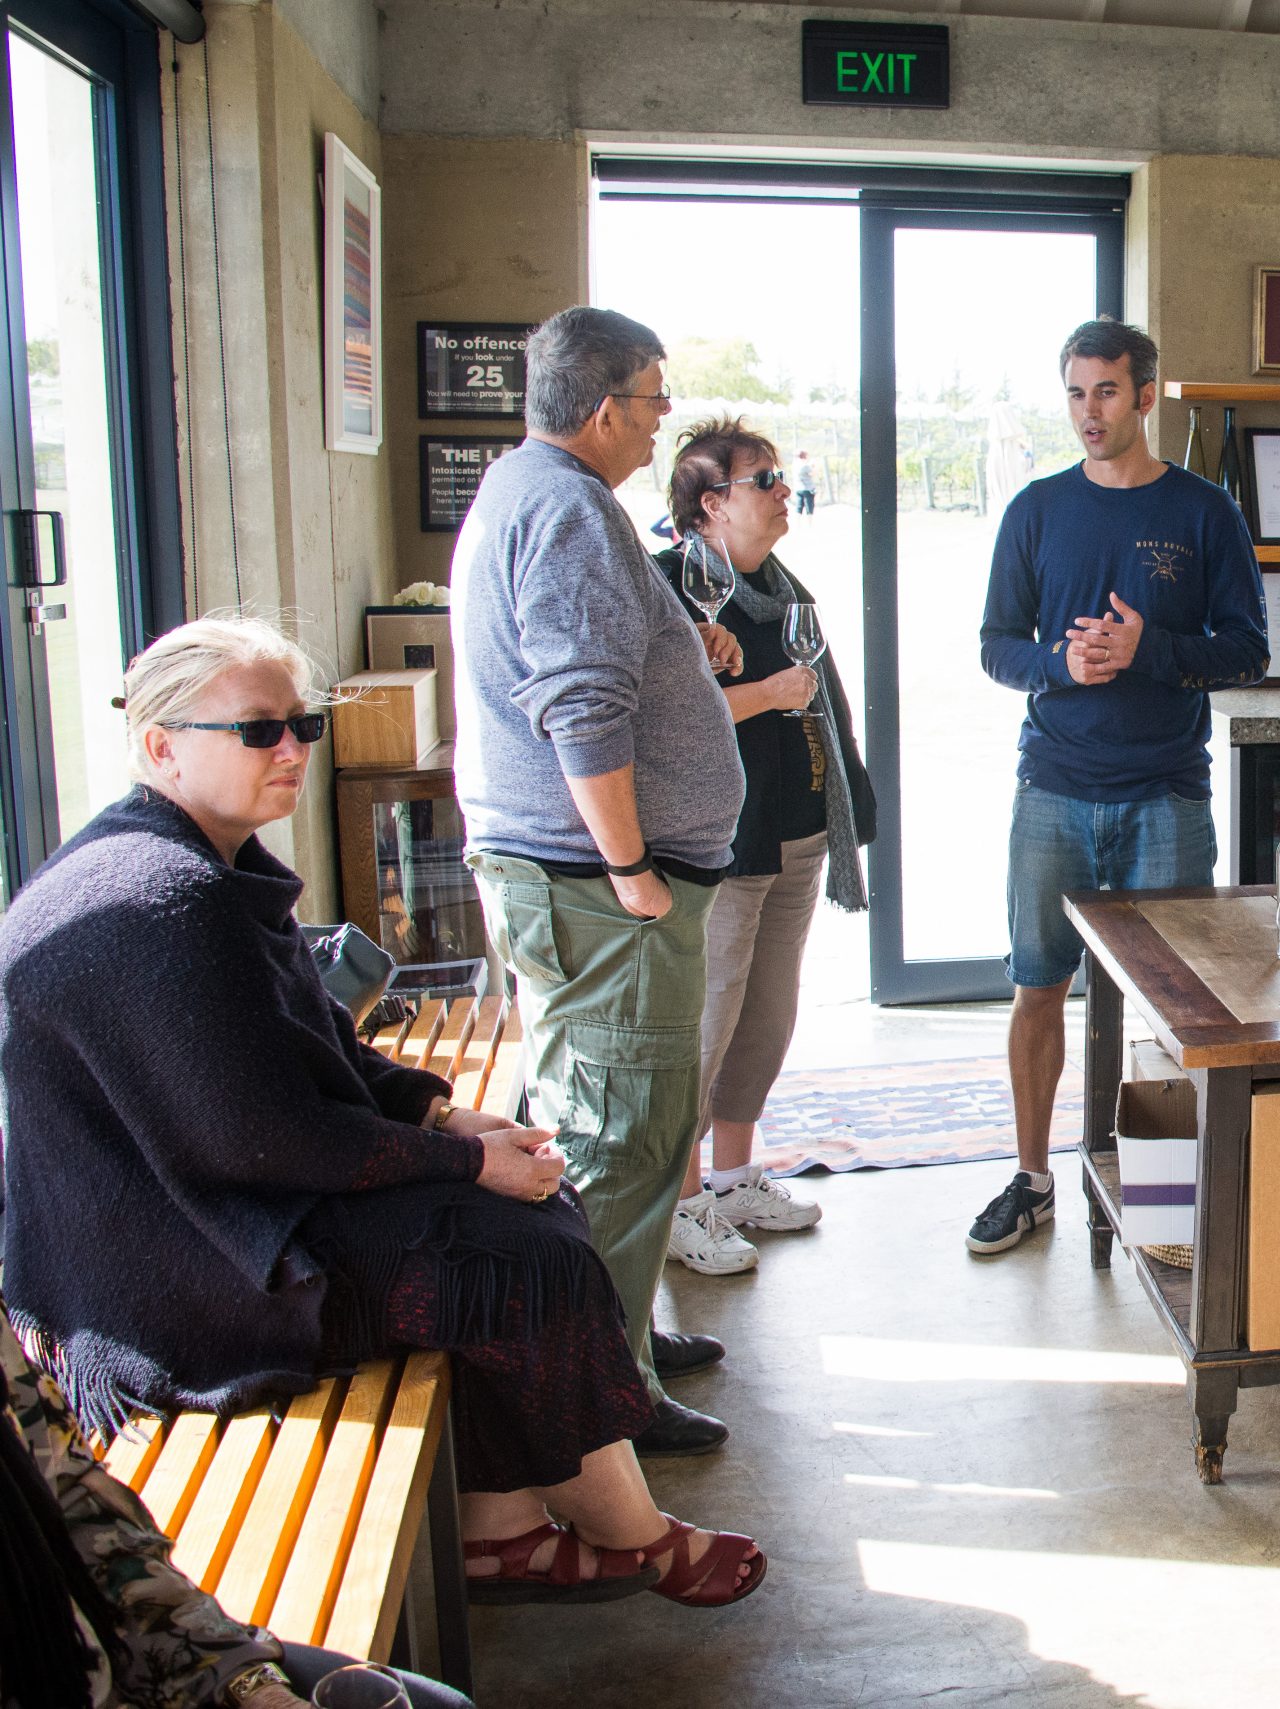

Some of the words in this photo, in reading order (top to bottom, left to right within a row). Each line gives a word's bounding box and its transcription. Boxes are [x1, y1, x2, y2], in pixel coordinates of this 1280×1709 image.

[836, 51, 918, 94] EXIT
[435, 336, 458, 349] No
[463, 336, 527, 351] offence
[475, 353, 495, 361] look
[466, 365, 504, 388] 25
[427, 390, 441, 398] You
[441, 390, 452, 398] will
[480, 390, 503, 399] prove
[504, 391, 524, 399] your
[441, 449, 481, 462] THE
[431, 467, 482, 475] Intoxicated
[432, 477, 466, 486] permitted
[432, 488, 455, 497] People
[1136, 541, 1159, 549] MONS
